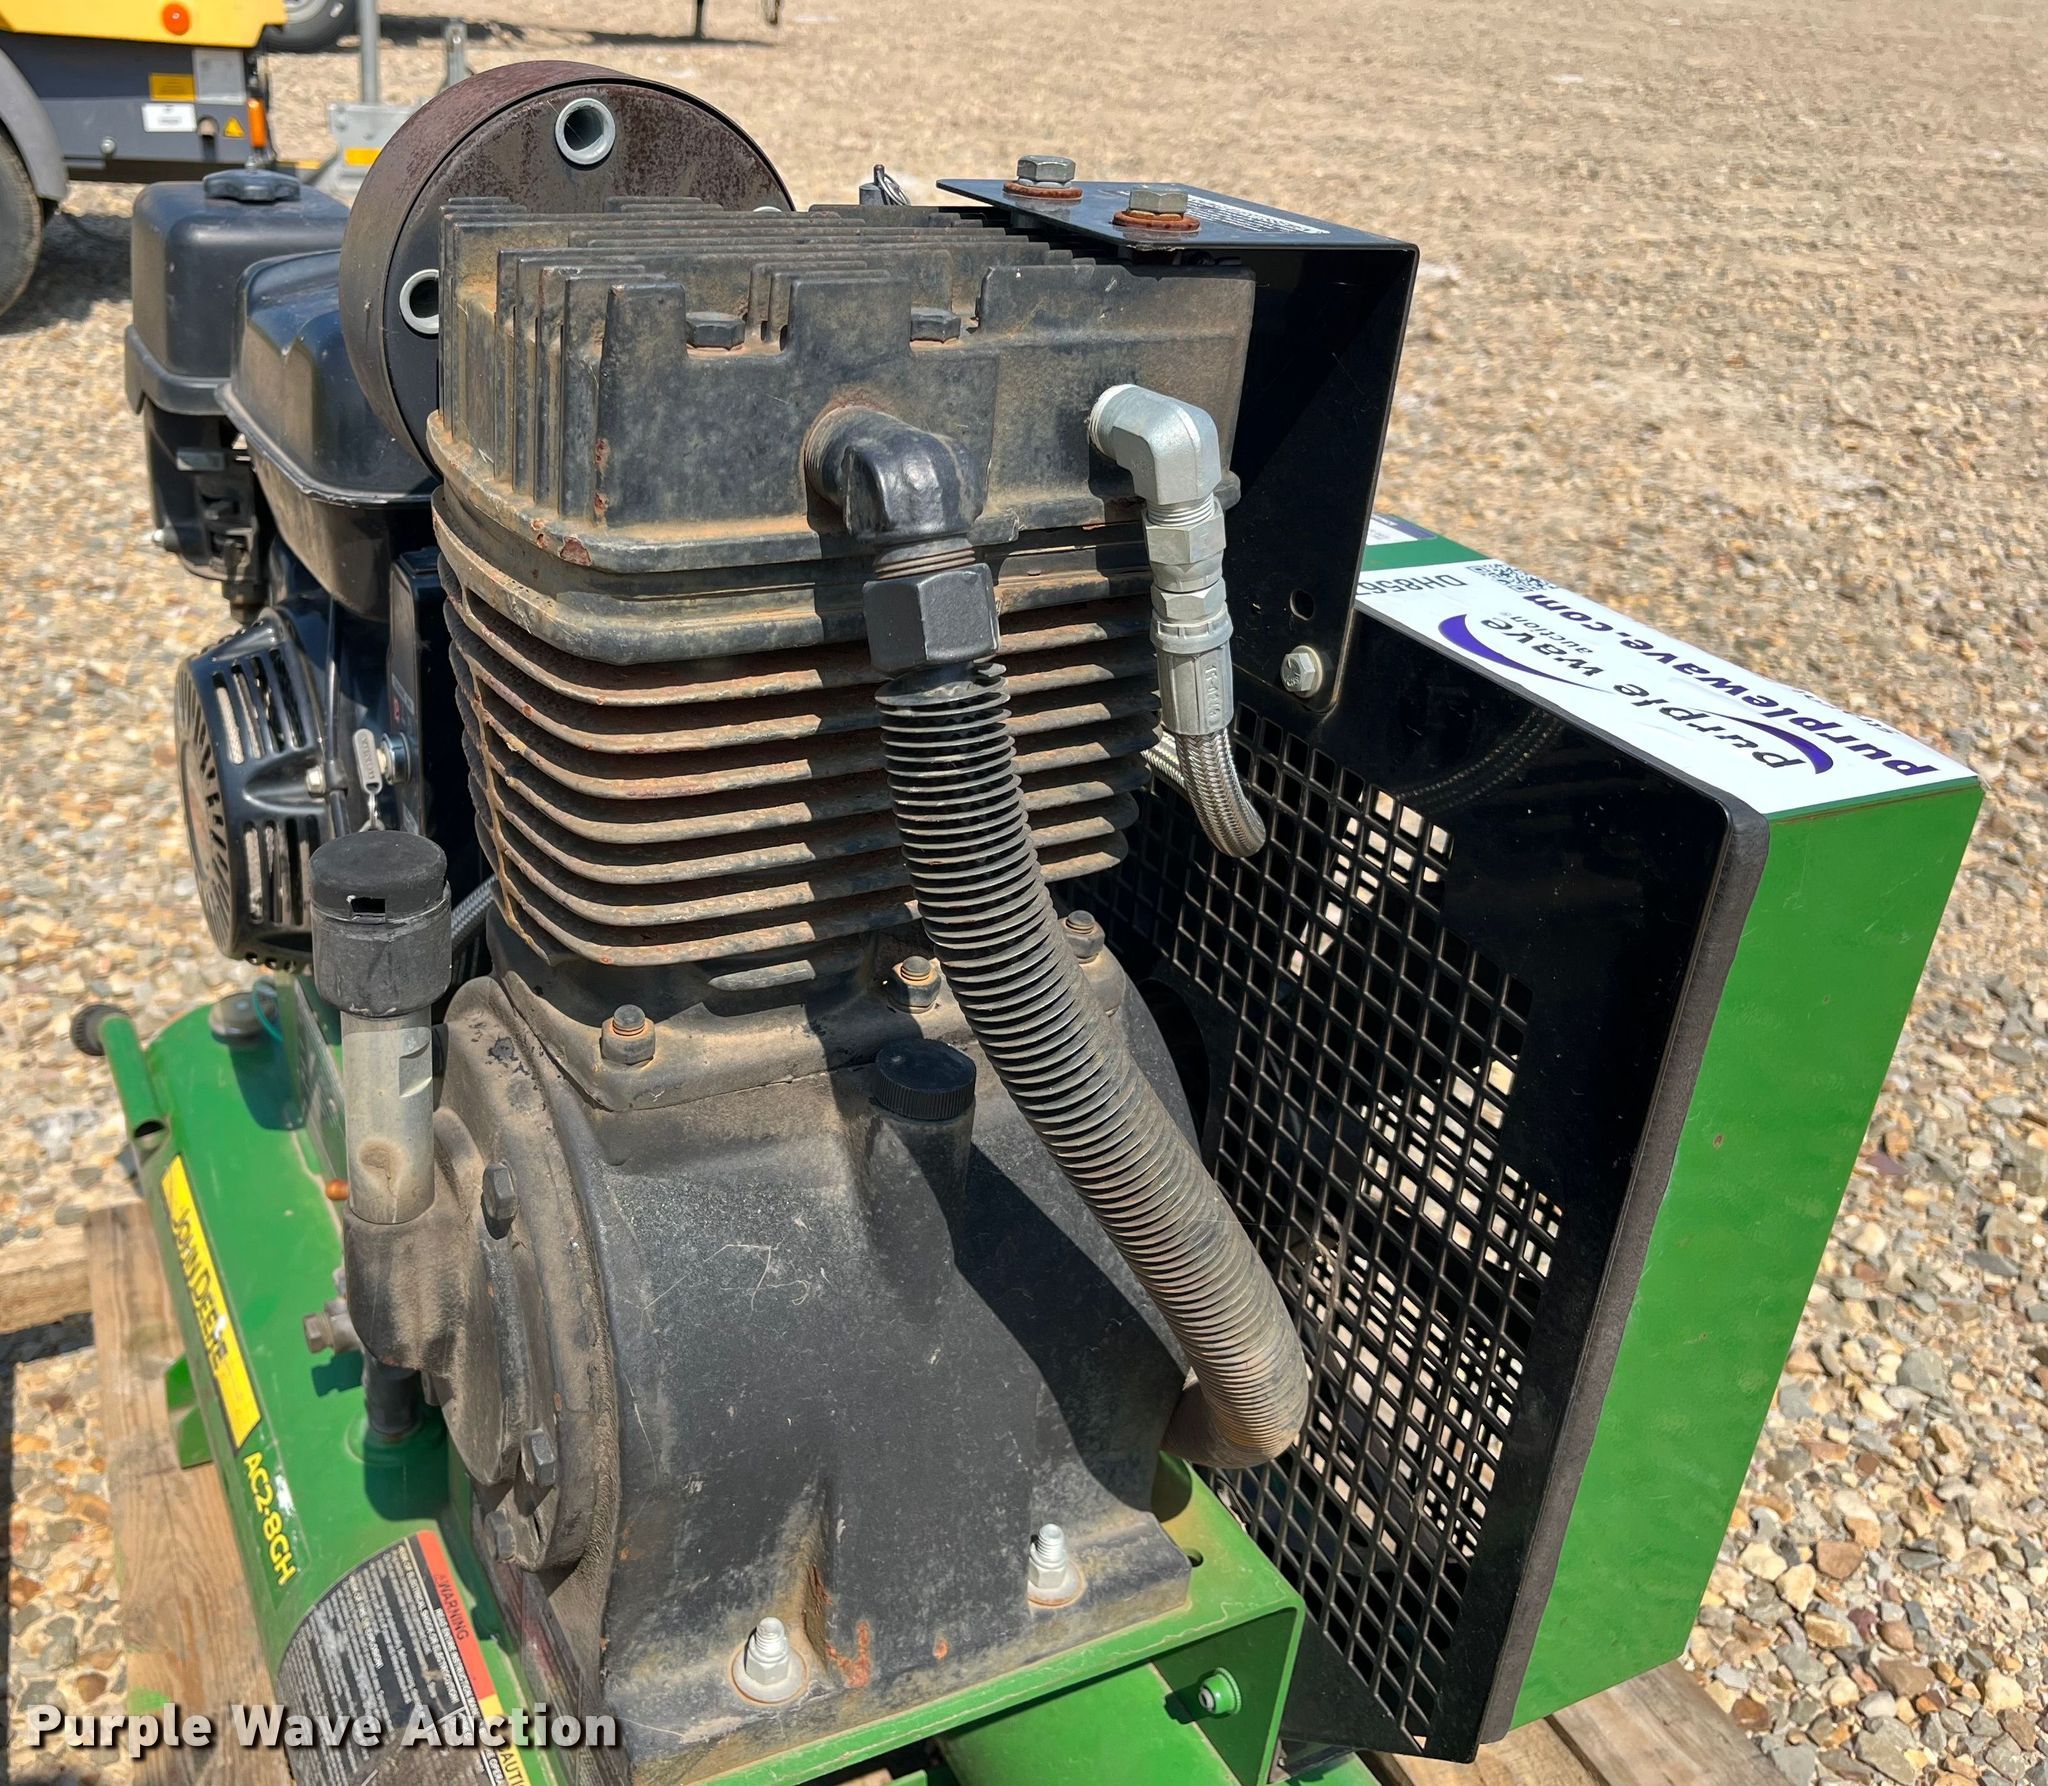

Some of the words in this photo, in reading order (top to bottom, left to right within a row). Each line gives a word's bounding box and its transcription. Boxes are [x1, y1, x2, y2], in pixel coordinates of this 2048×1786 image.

[1481, 617, 1604, 677] wave
[1523, 594, 1939, 775] purplewave.com
[1613, 683, 1806, 769] purple
[172, 1207, 203, 1281] JOHN
[189, 1269, 228, 1371] DEERE
[244, 1451, 297, 1586] AC2-8GH
[439, 1581, 469, 1640] WARNING
